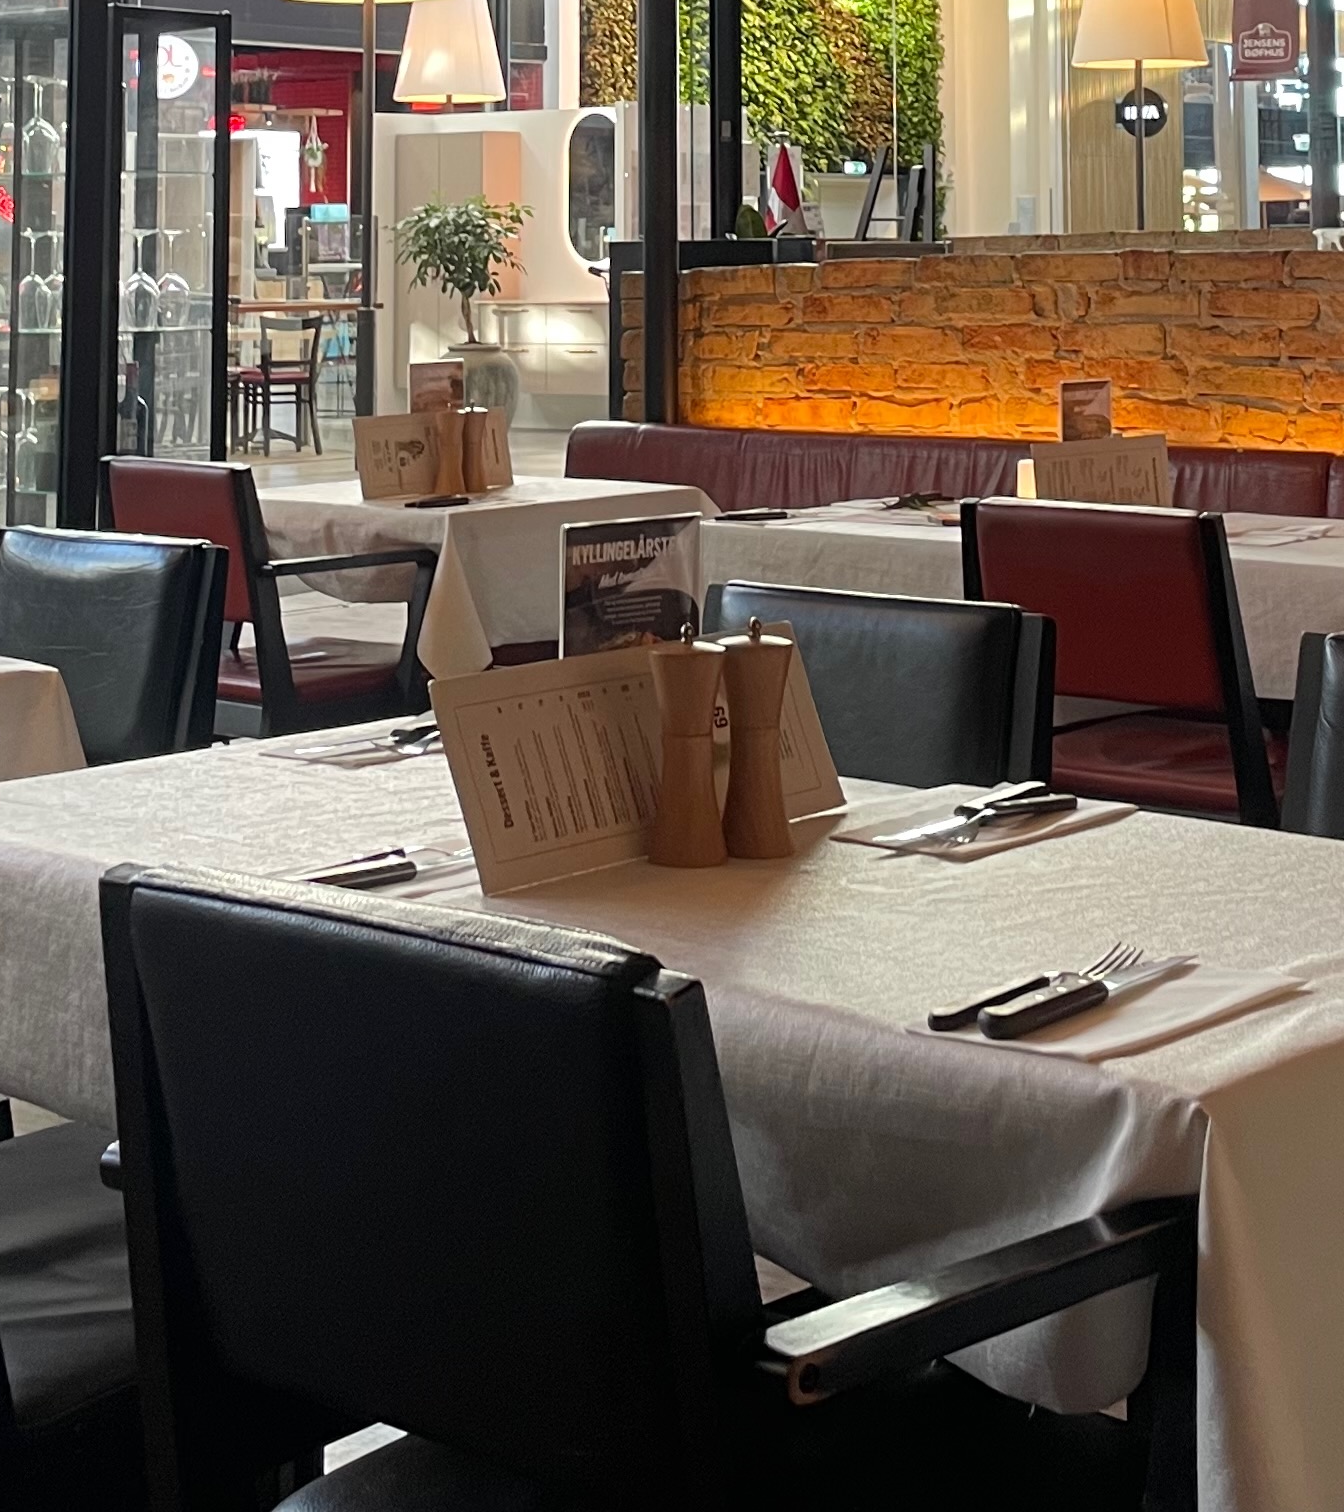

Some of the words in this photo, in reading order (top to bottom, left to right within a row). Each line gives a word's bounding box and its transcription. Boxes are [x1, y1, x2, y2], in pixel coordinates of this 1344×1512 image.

[1242, 38, 1286, 48] JENSENS
[1244, 47, 1285, 58] BØFHUS
[480, 734, 497, 768] Kaffe
[489, 768, 500, 779] &
[493, 780, 515, 829] Dessert
